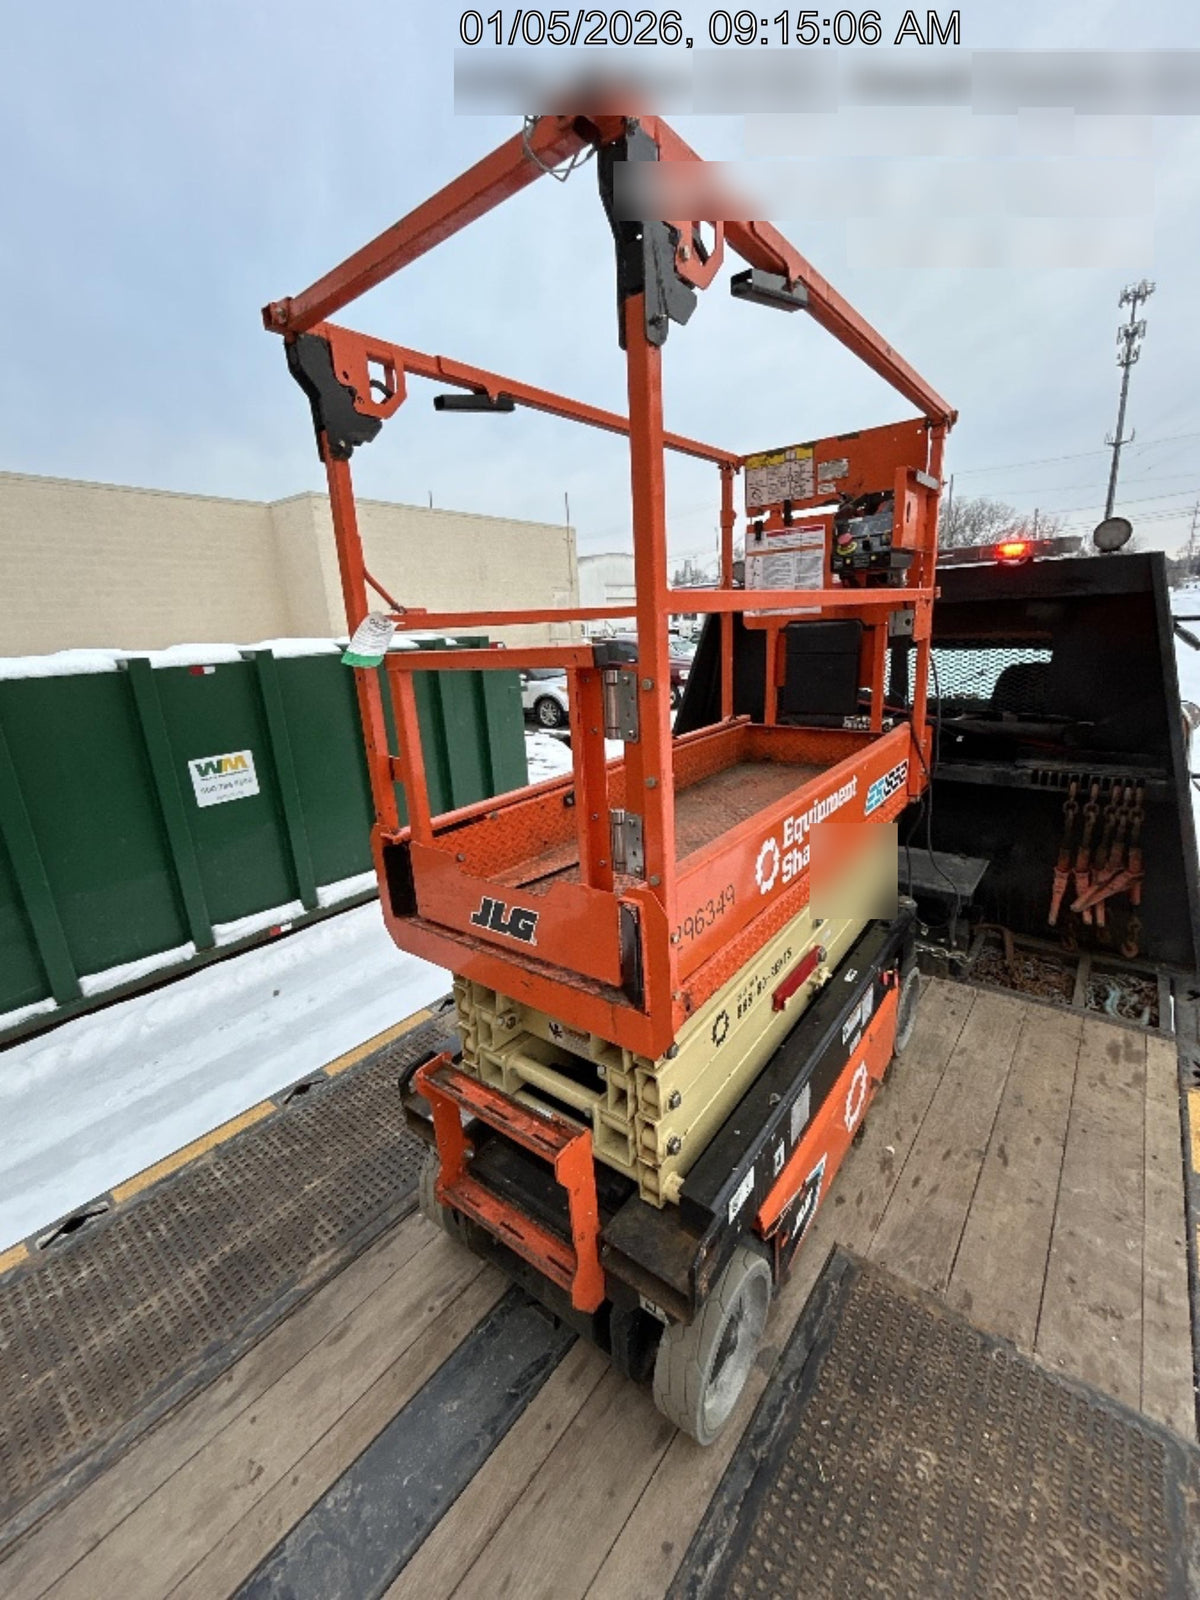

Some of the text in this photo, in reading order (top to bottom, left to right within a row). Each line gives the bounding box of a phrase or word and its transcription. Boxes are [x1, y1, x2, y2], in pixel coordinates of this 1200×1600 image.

[194, 754, 249, 778] WM
[782, 774, 858, 850] Equipment
[470, 896, 539, 946] JLG
